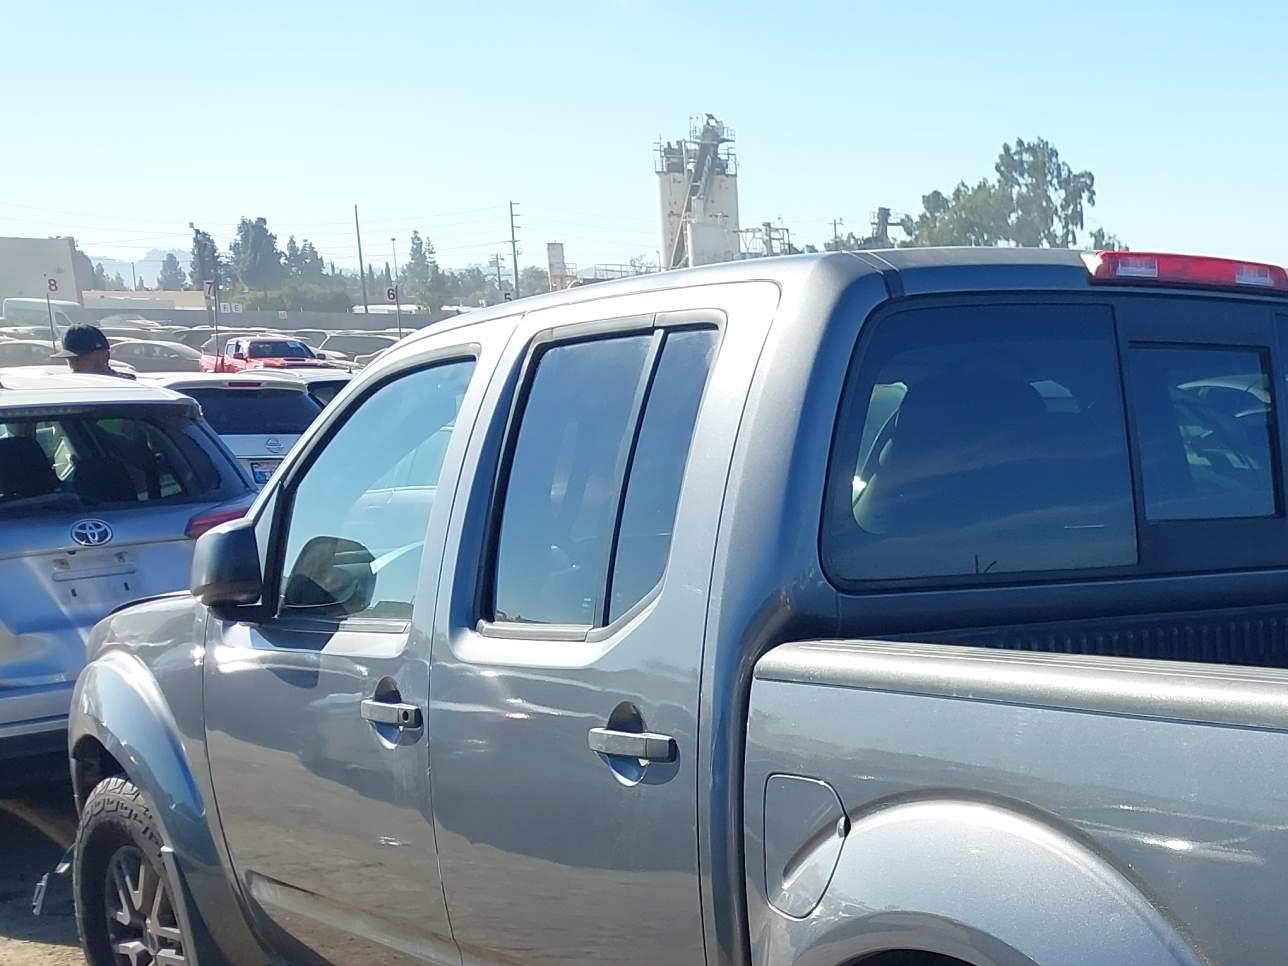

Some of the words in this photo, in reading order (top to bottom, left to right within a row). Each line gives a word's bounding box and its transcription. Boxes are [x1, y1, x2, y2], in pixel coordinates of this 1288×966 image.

[48, 278, 58, 292] 8
[206, 281, 215, 296] 7
[387, 288, 396, 300] 6
